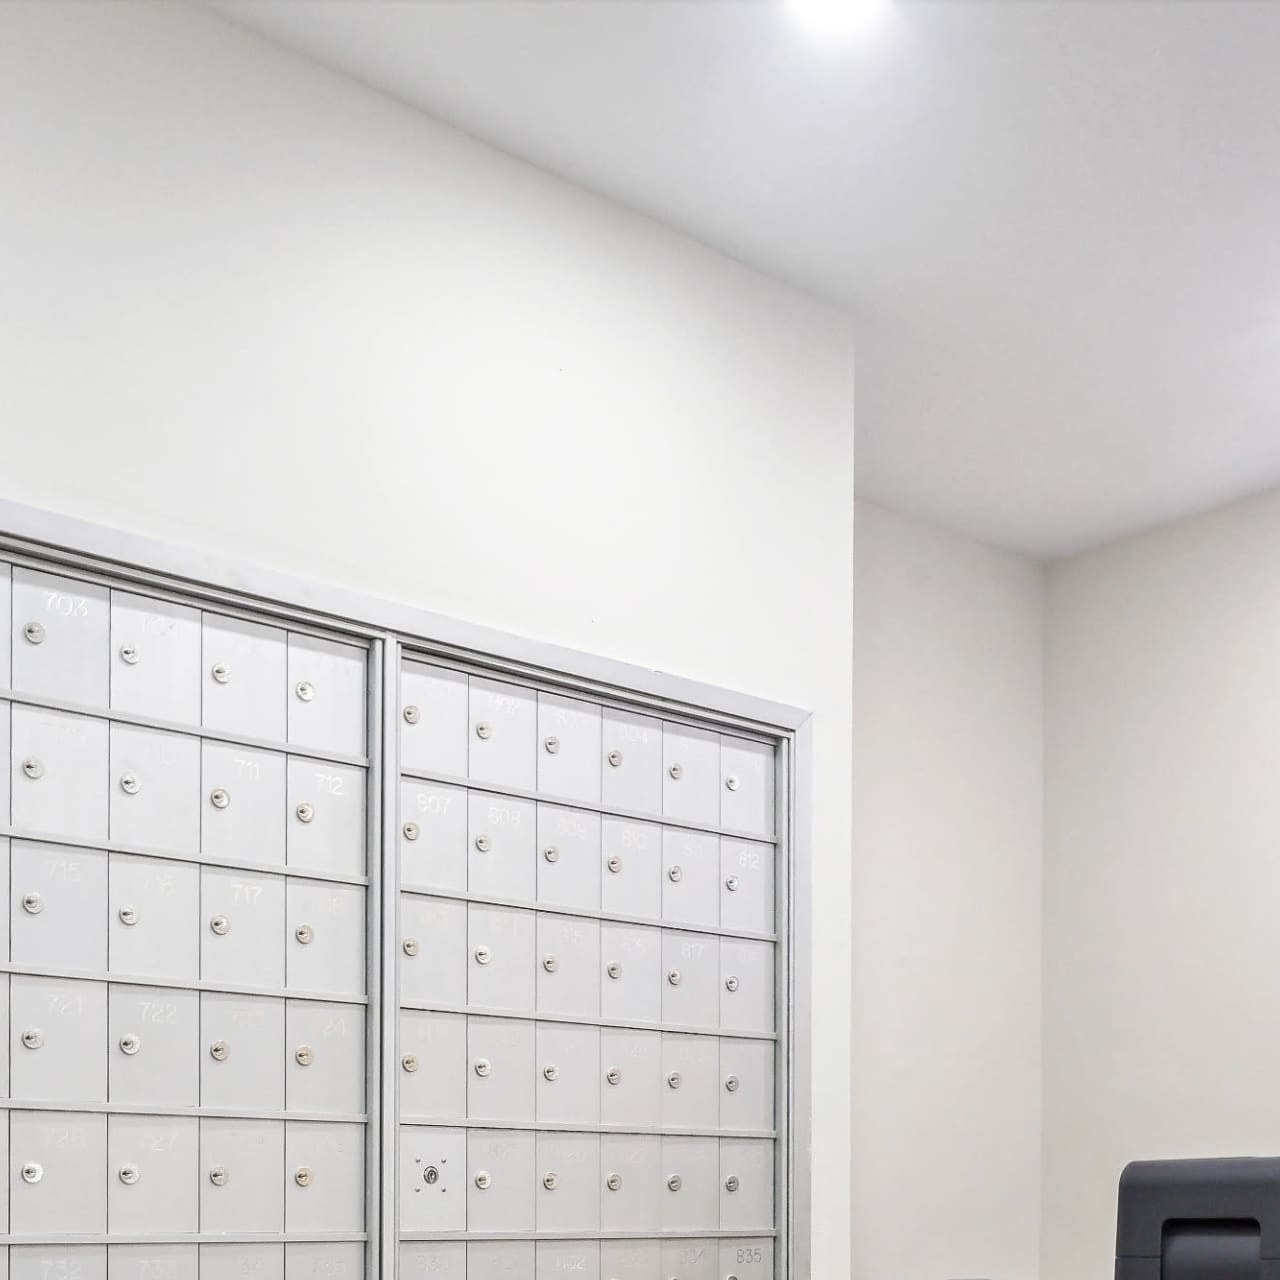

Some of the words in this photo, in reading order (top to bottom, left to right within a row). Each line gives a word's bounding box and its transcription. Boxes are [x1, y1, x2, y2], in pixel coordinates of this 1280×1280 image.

[315, 774, 343, 794] 712
[231, 885, 262, 905] 717
[138, 1002, 176, 1024] 722
[736, 1249, 761, 1264] 835
[40, 1261, 84, 1280] 732
